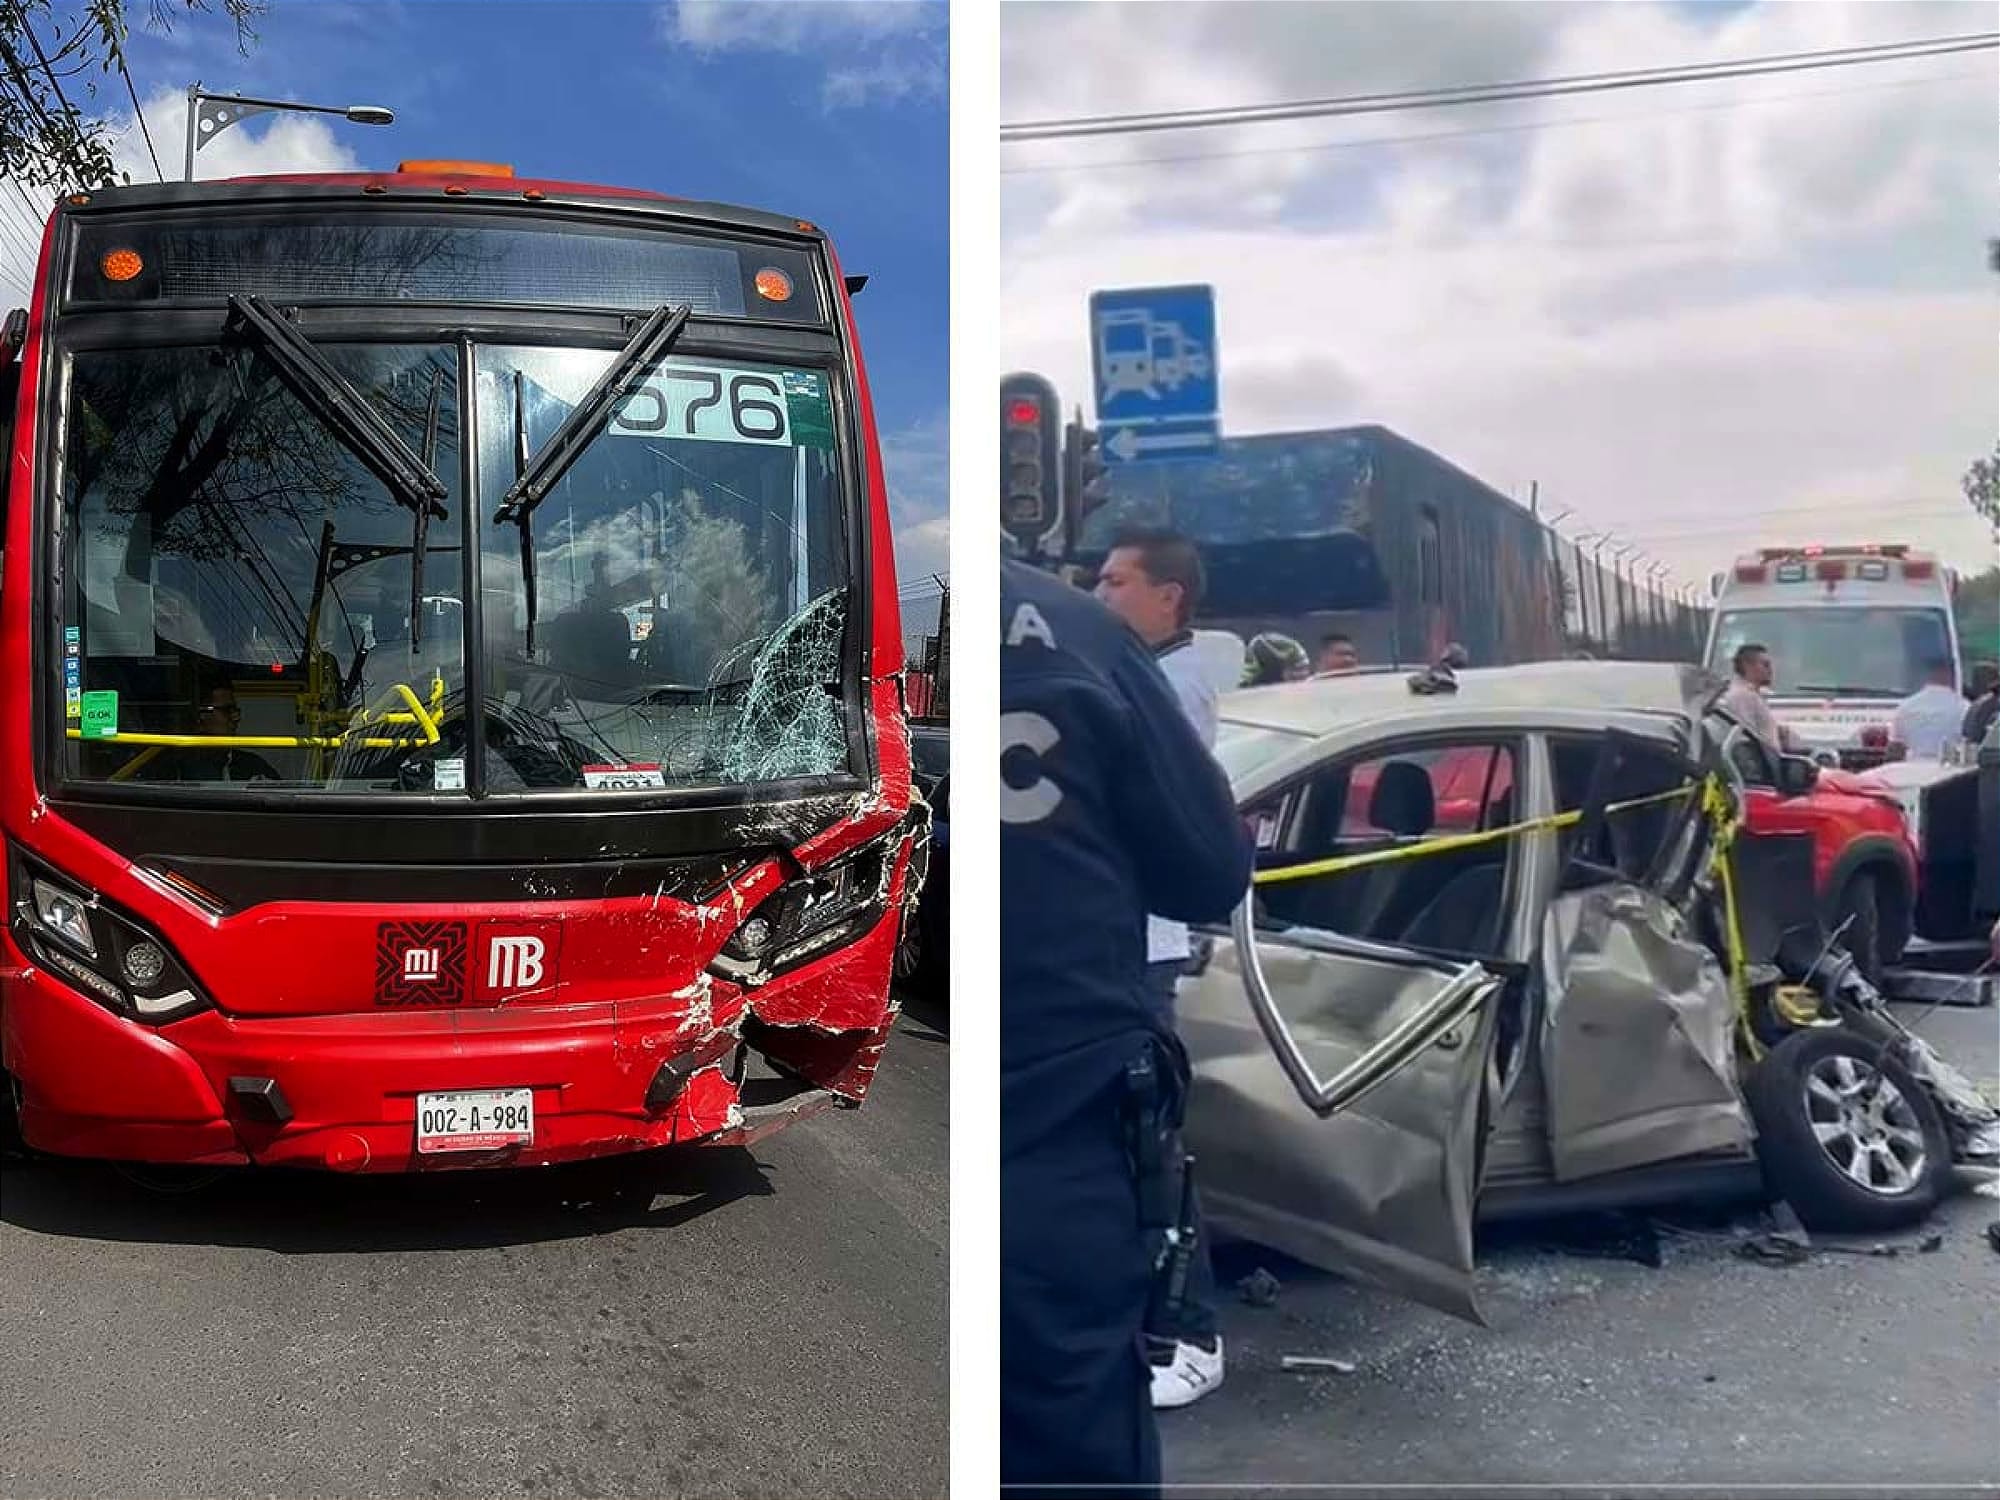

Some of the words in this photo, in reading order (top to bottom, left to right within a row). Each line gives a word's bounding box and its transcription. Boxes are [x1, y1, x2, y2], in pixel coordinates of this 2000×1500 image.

[1001, 712, 1063, 823] C
[488, 936, 545, 987] MB
[422, 1106, 529, 1133] 002-A-984
